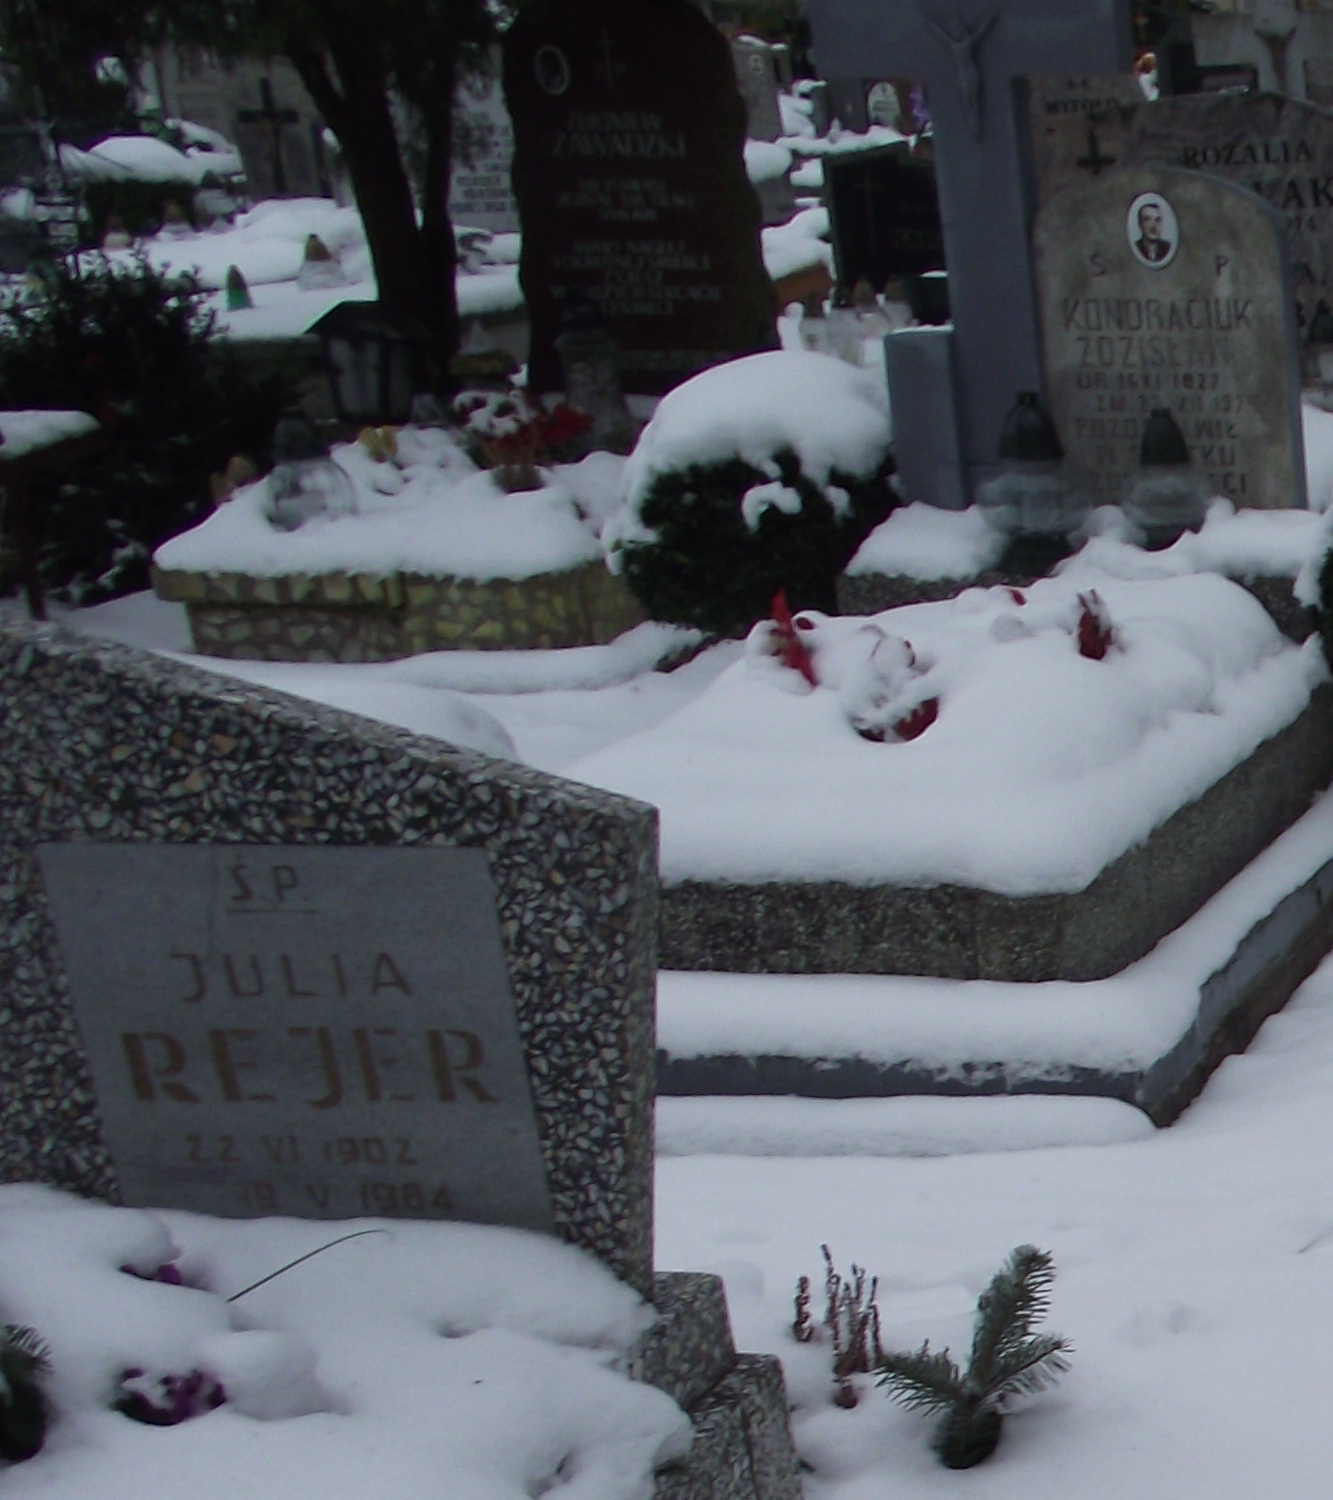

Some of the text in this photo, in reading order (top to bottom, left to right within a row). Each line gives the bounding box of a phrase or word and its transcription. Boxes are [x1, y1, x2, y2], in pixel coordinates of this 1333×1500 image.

[1182, 140, 1314, 168] ROZALIA
[1061, 298, 1253, 332] KONDRACIUK
[170, 951, 414, 1003] JULIA
[119, 1026, 500, 1110] REJER
[260, 1133, 300, 1165] VI
[323, 1136, 418, 1167] 1902
[305, 1183, 330, 1211] V
[359, 1181, 456, 1212] 1984
